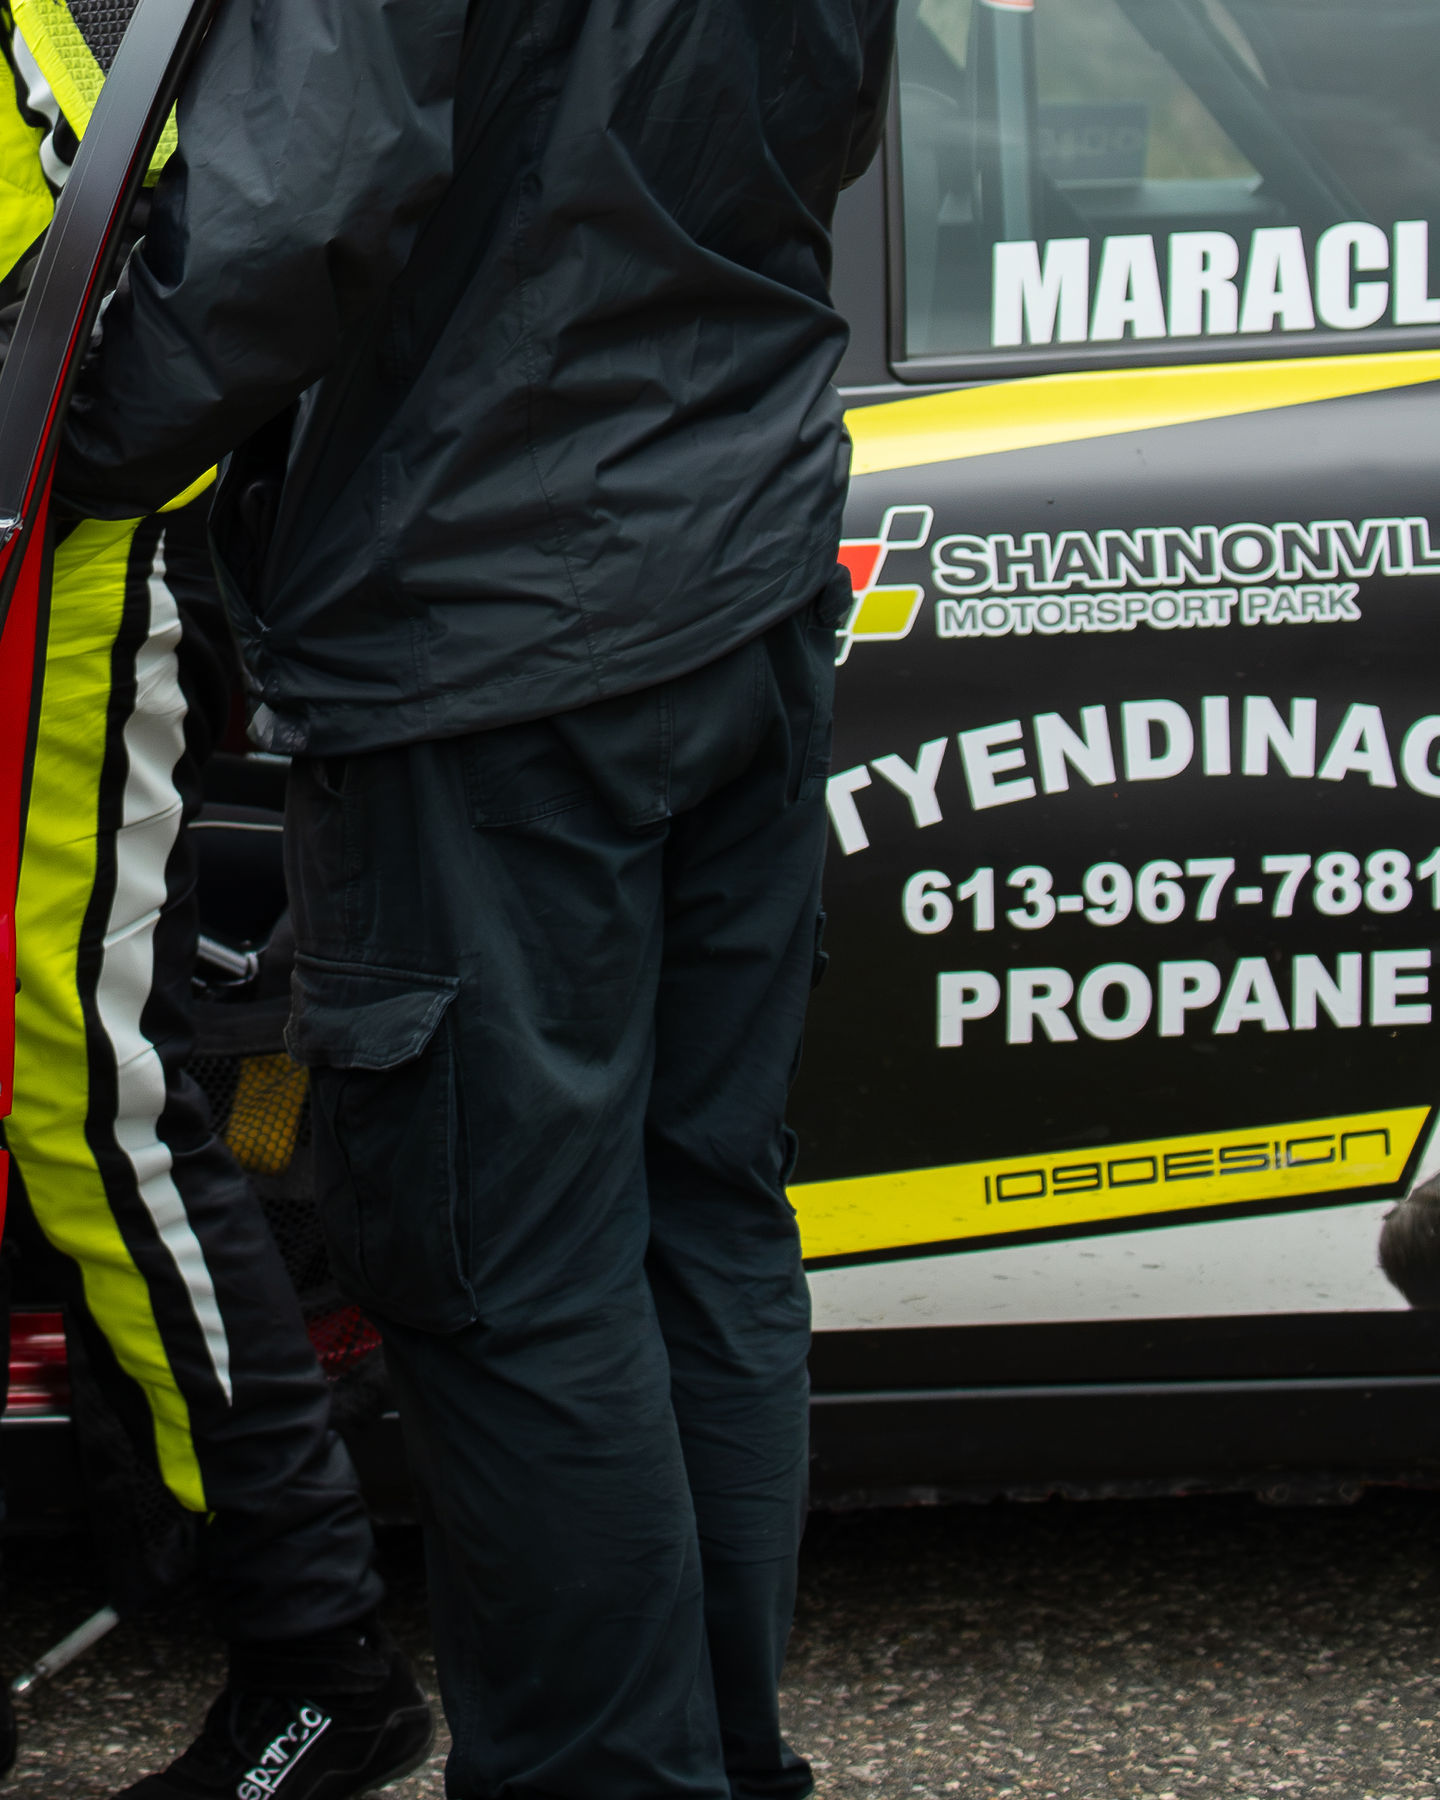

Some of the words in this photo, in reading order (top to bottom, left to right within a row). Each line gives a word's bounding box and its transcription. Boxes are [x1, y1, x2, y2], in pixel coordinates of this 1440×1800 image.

[935, 587, 1237, 638] MOTORSPORT
[1239, 583, 1361, 625] PARK
[936, 948, 1432, 1048] PROPANE
[236, 1706, 323, 1800] sparco
